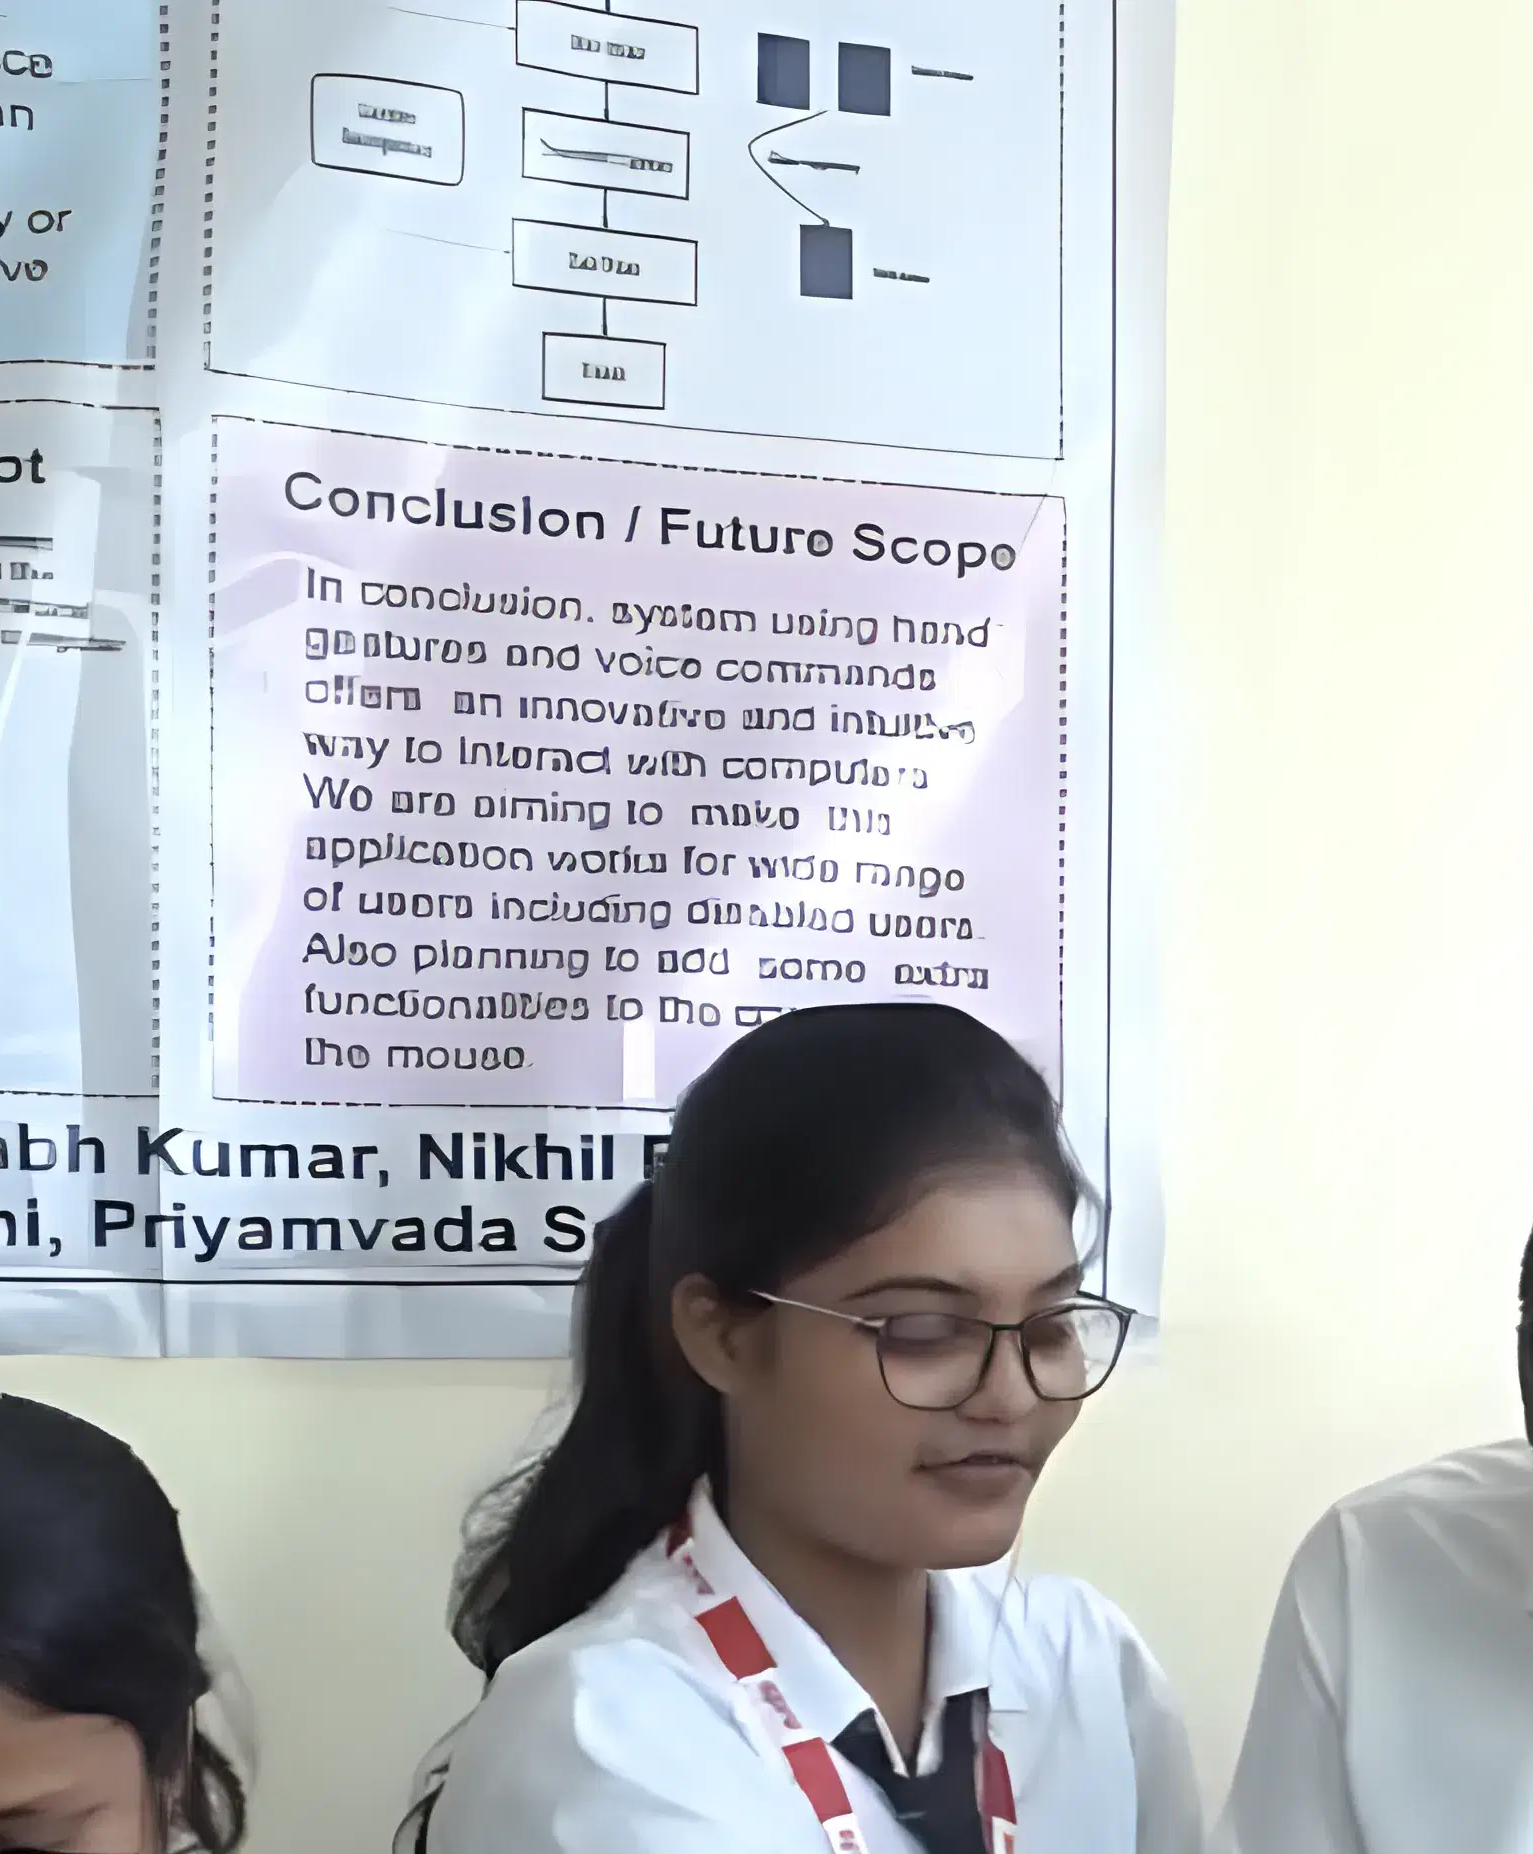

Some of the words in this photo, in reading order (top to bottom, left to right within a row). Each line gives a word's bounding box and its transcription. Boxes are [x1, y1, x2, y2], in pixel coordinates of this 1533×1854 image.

[285, 472, 604, 540] Conclusion
[625, 505, 641, 542] /
[661, 507, 833, 557] Future
[853, 523, 1016, 579] Scope
[138, 1122, 389, 1188] Kumar,
[420, 1132, 614, 1182] Nikhil
[94, 1200, 517, 1270] Priyamvada
